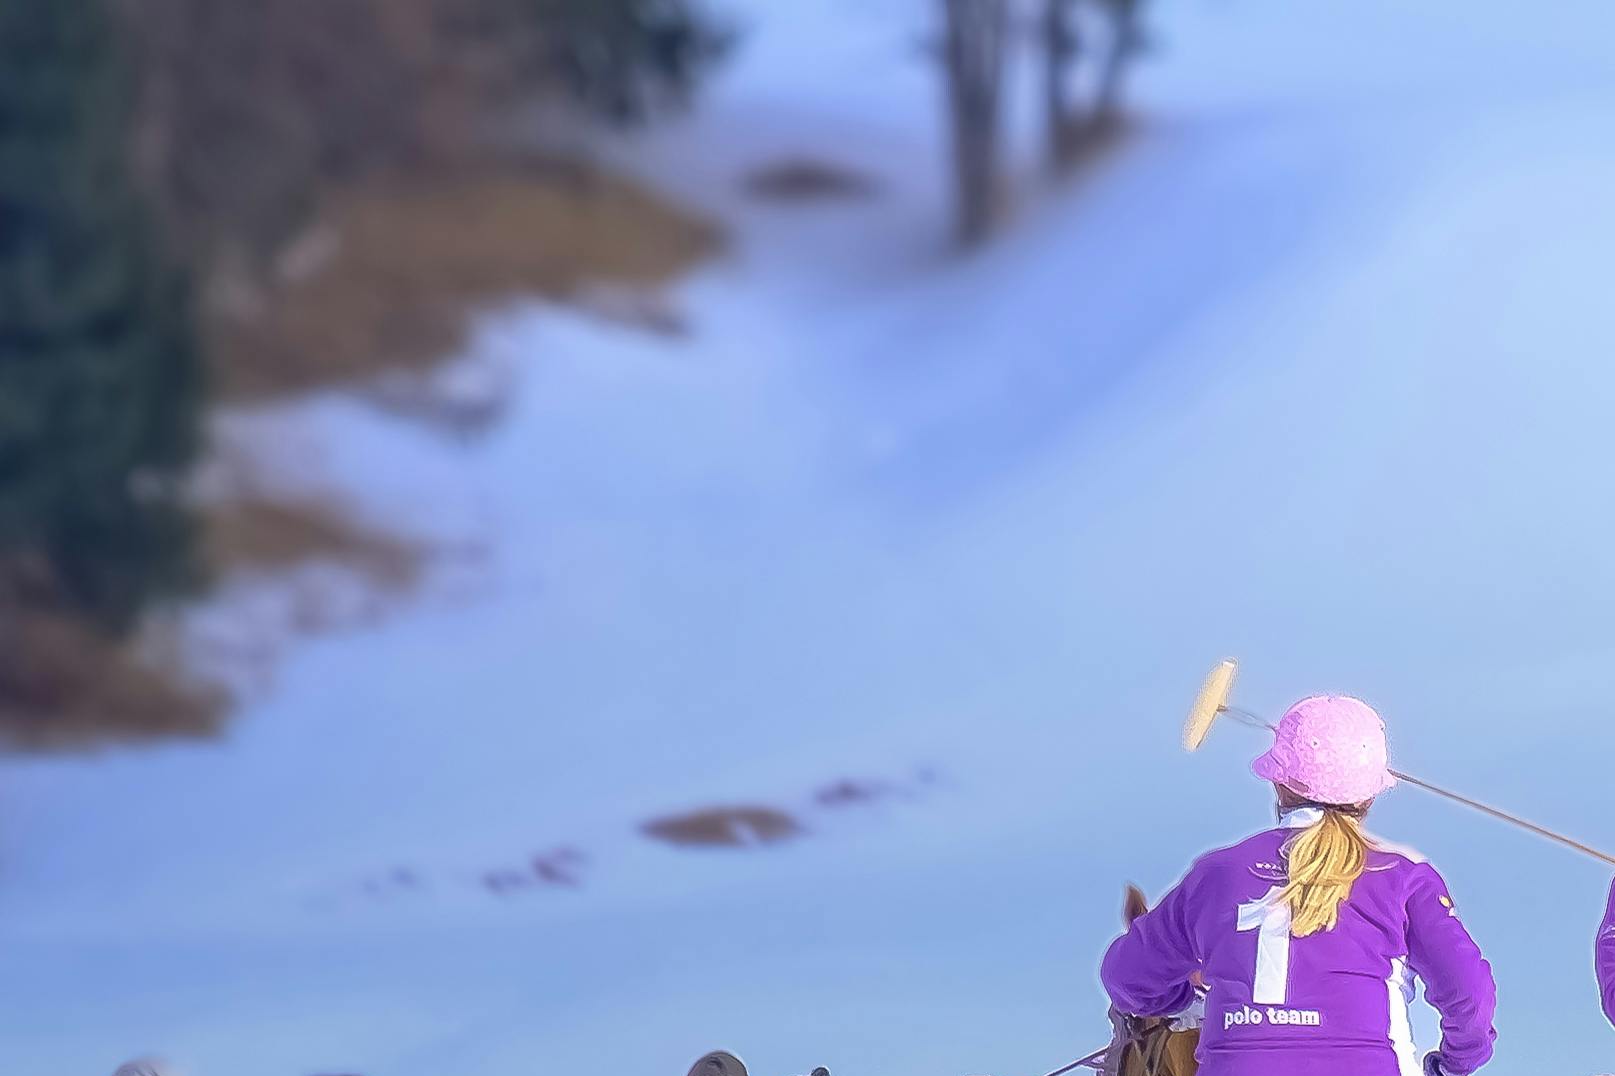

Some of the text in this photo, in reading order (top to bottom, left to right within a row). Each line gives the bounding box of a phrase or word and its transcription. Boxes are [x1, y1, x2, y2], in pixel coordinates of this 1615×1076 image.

[1237, 885, 1291, 1005] 1
[1224, 1004, 1320, 1030] polo team
